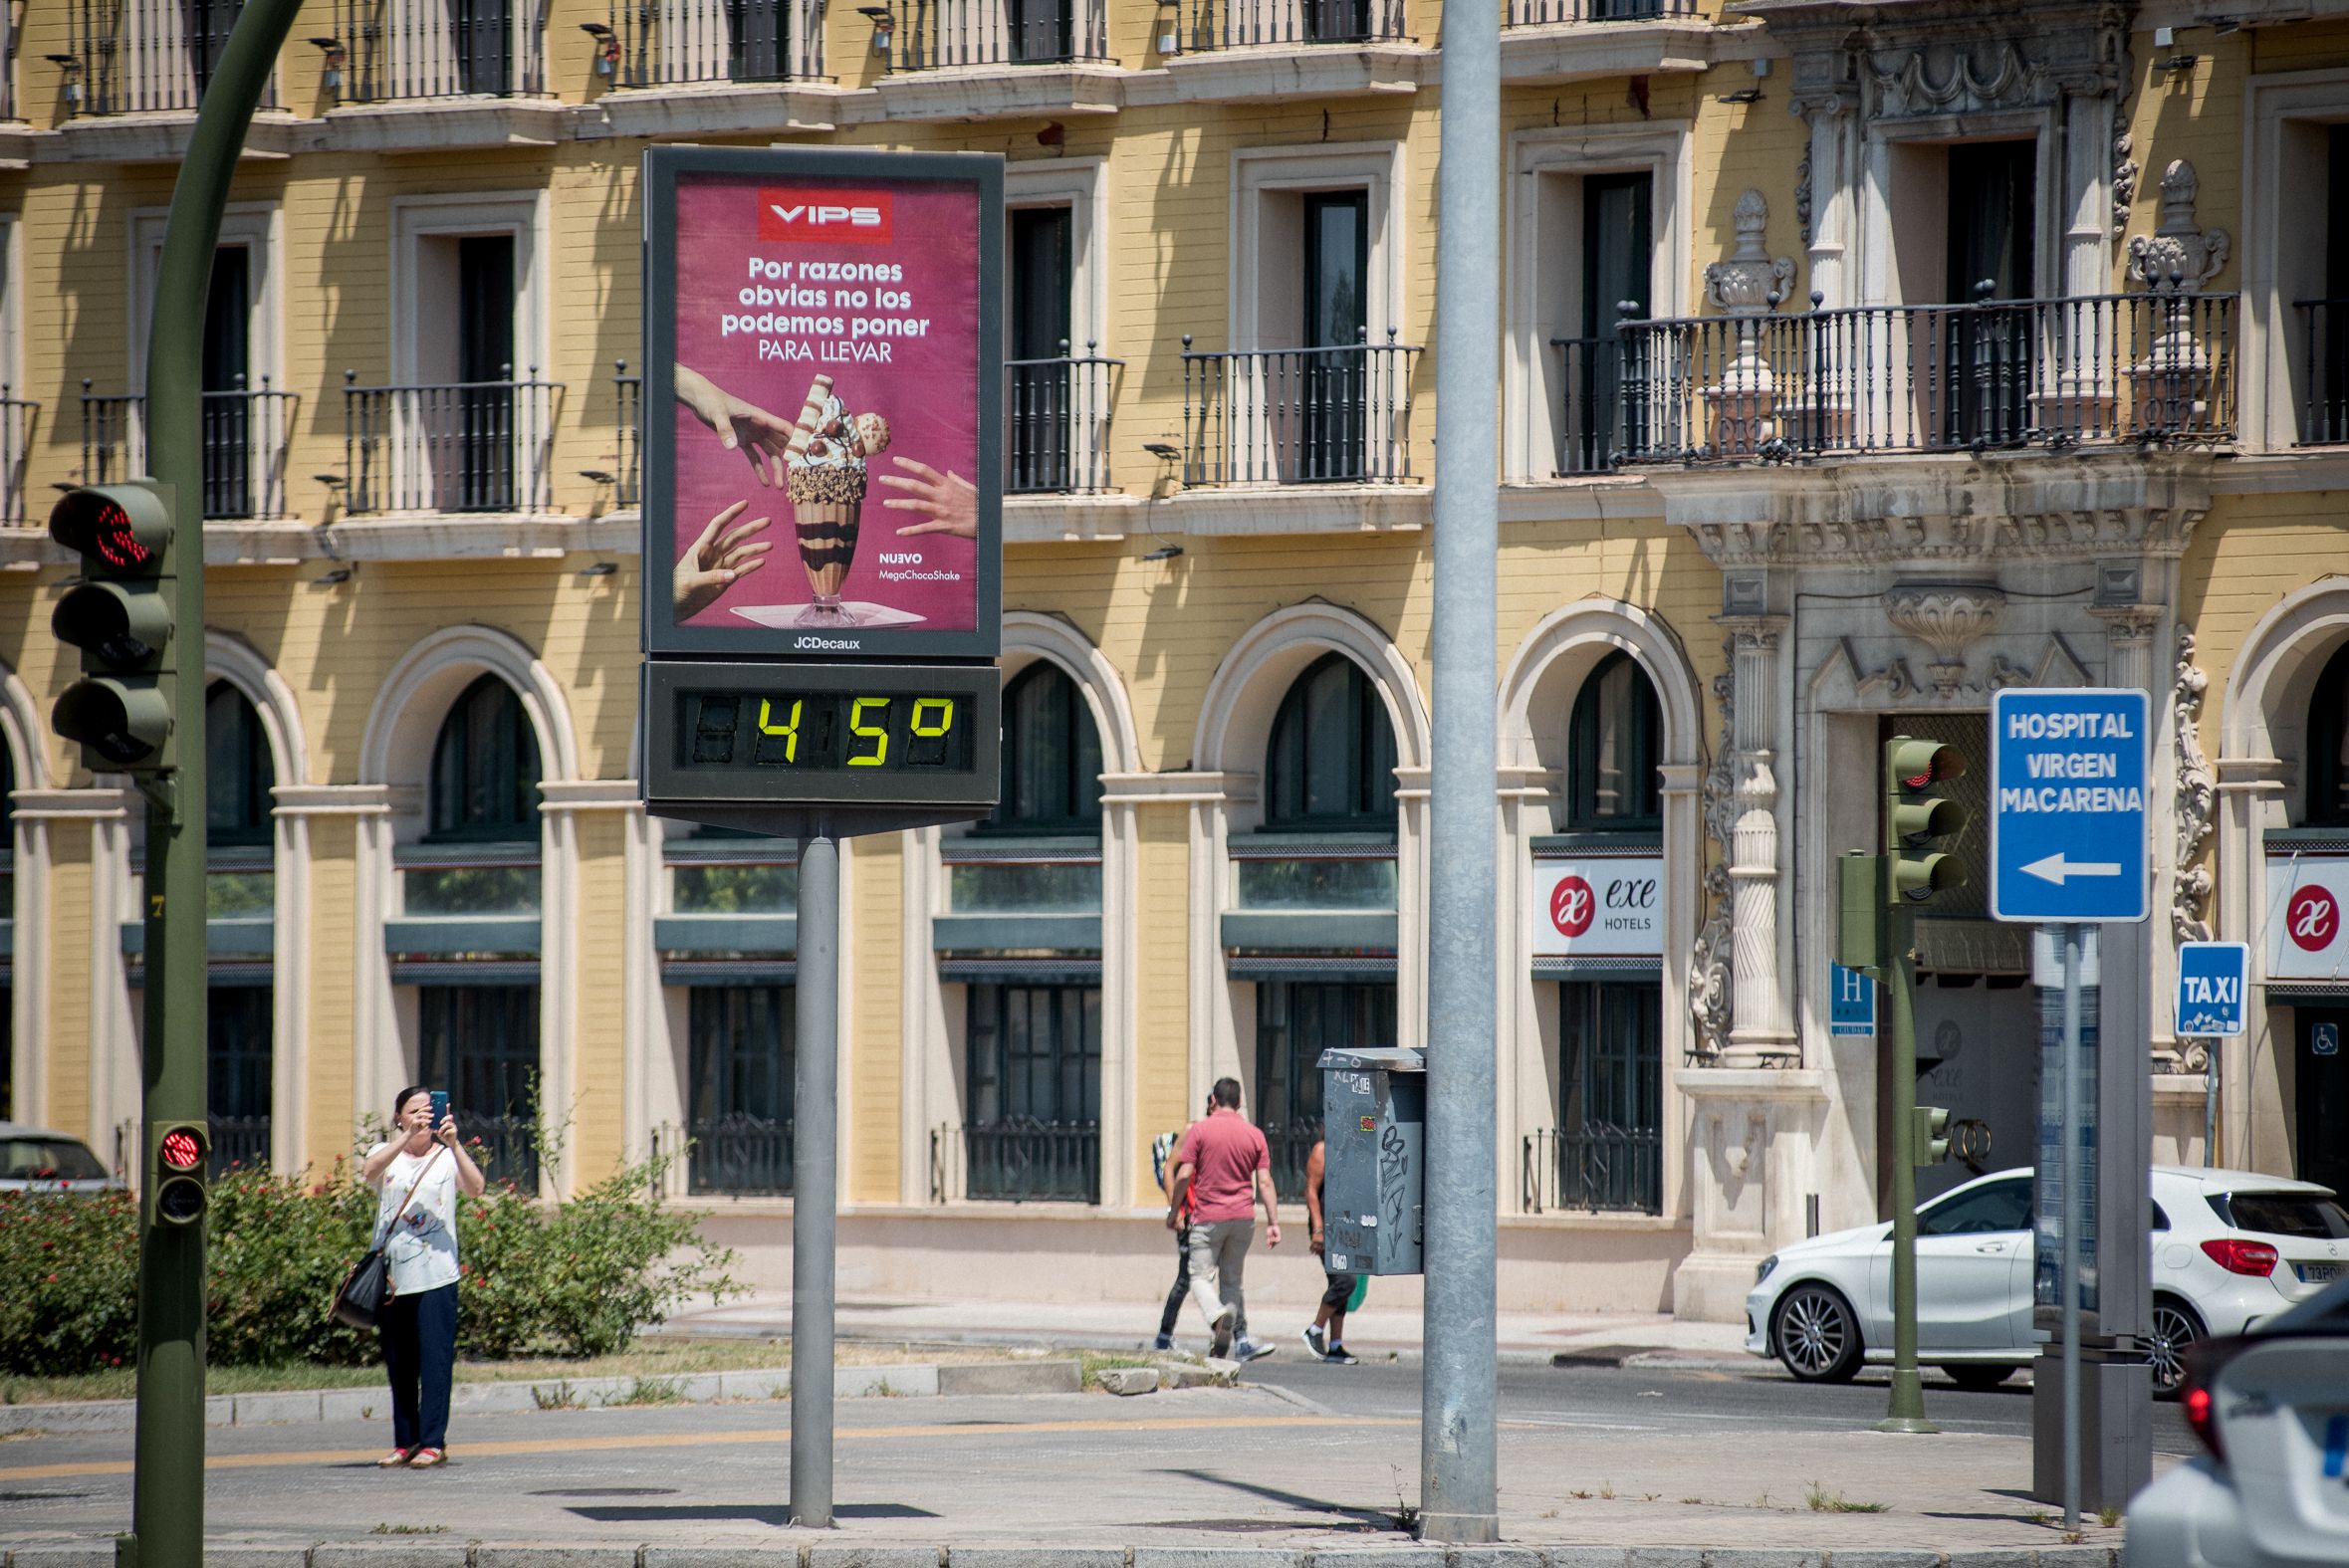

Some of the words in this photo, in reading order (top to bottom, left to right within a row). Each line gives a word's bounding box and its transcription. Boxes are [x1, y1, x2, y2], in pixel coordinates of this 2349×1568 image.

[770, 204, 881, 225] VIPS
[749, 257, 793, 280] Por
[799, 260, 903, 282] razones
[739, 283, 827, 307] obvias
[834, 290, 868, 309] no
[875, 288, 911, 310] los
[721, 313, 844, 336] podemos
[851, 317, 930, 339] poner
[759, 338, 815, 361] PARA
[821, 340, 892, 363] LLEVAR
[878, 569, 961, 581] MegaChocoShake
[793, 636, 861, 650] JCDecaux
[2008, 713, 2134, 740] HOSPITAL
[2026, 753, 2117, 779] VIRGEN
[1999, 786, 2144, 813] MACARENA
[1605, 918, 1651, 931] HOTELS
[1841, 968, 1863, 1003] H
[2184, 977, 2238, 1004] TAXI
